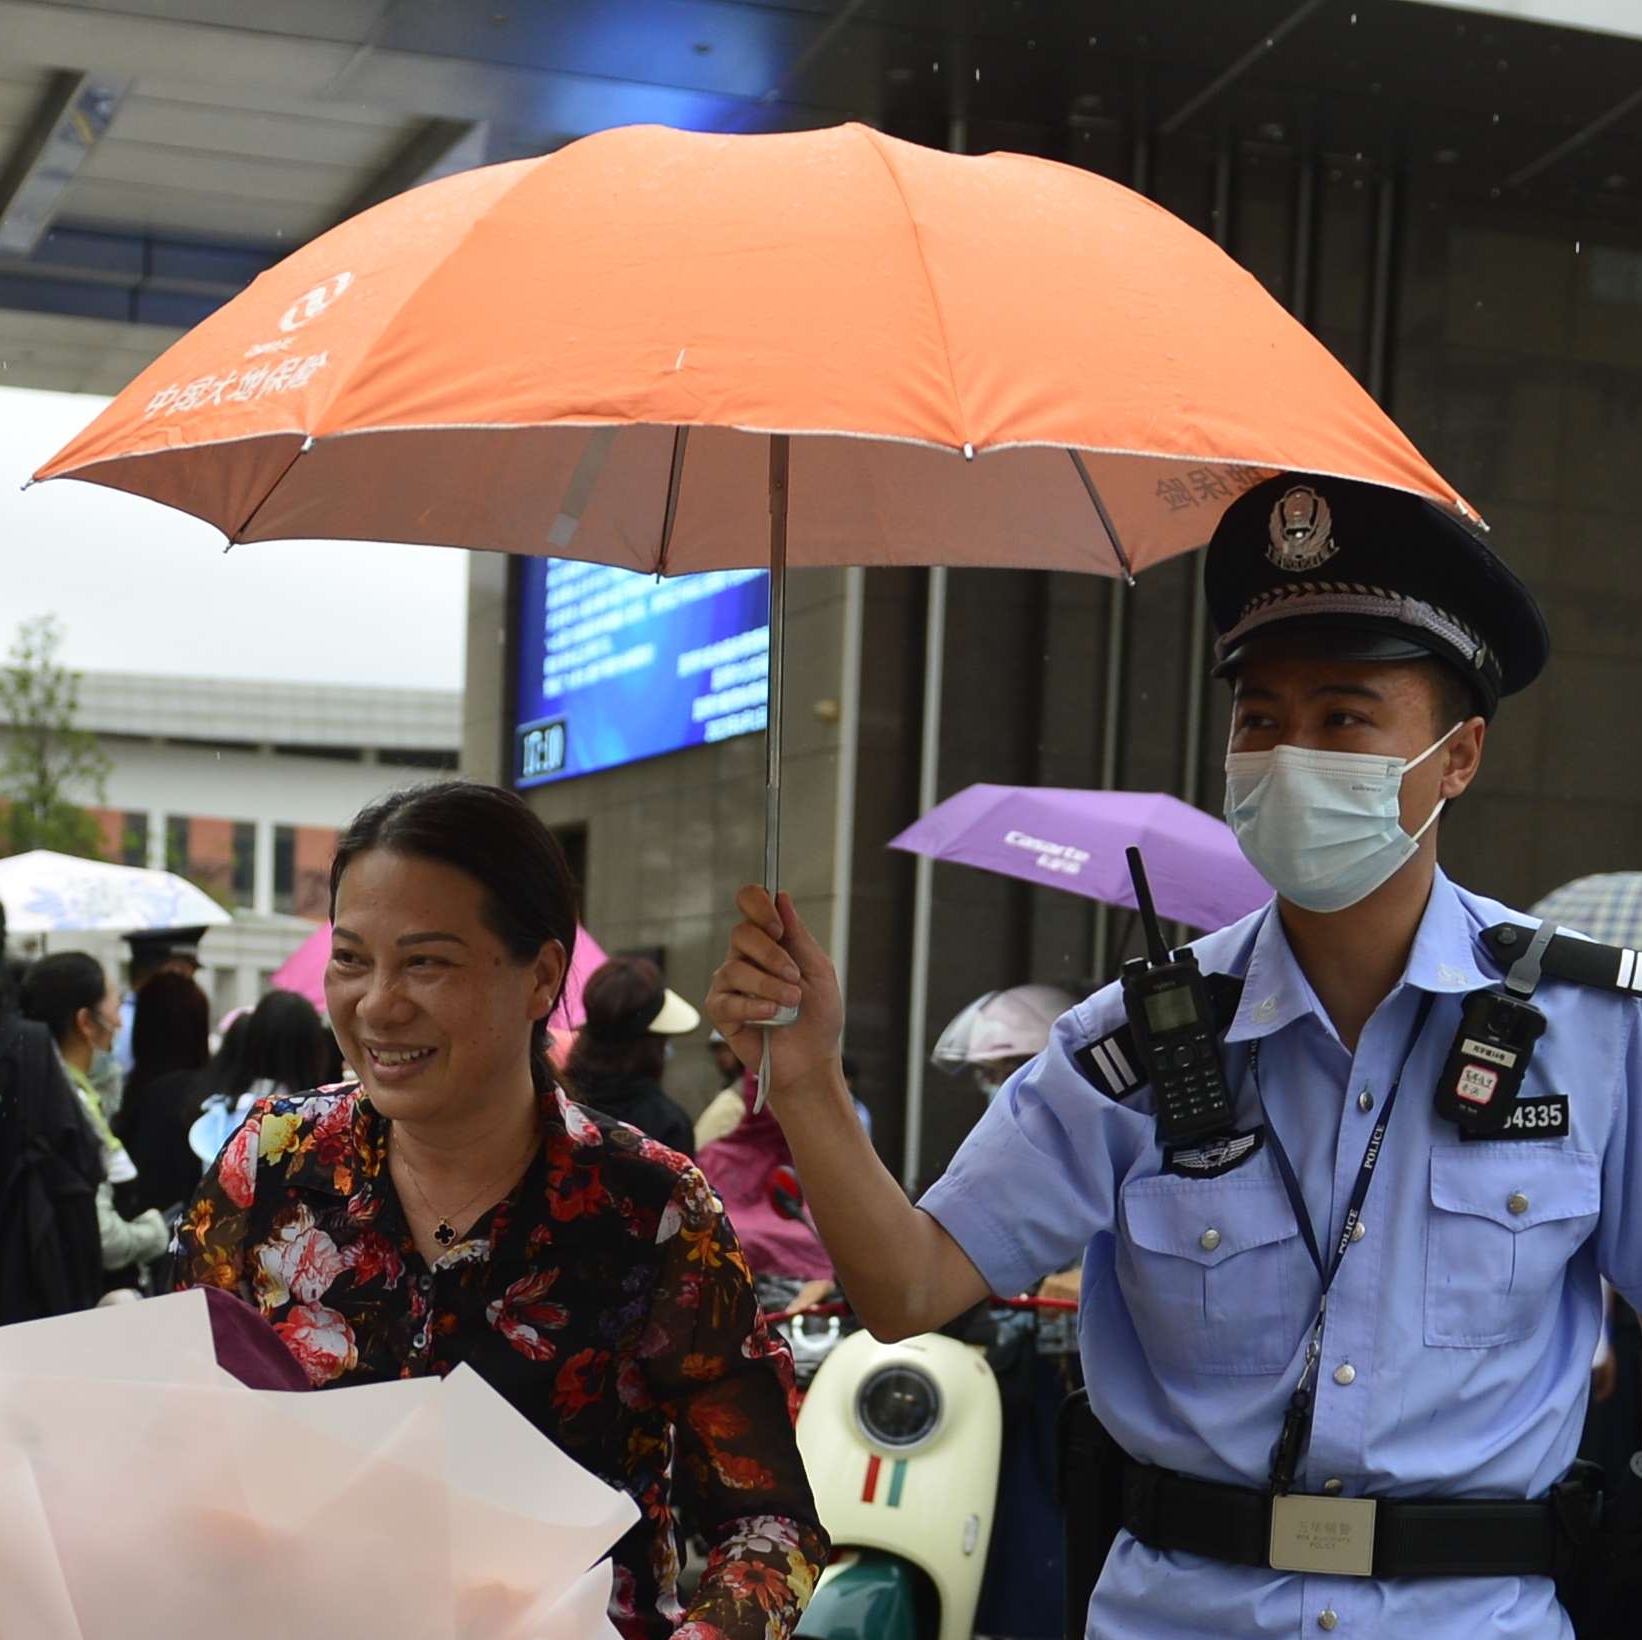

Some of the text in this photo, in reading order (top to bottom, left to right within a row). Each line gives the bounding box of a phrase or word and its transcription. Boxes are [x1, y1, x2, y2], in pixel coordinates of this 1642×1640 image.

[144, 351, 328, 420] 中国大地保险
[1503, 1103, 1563, 1129] 4335
